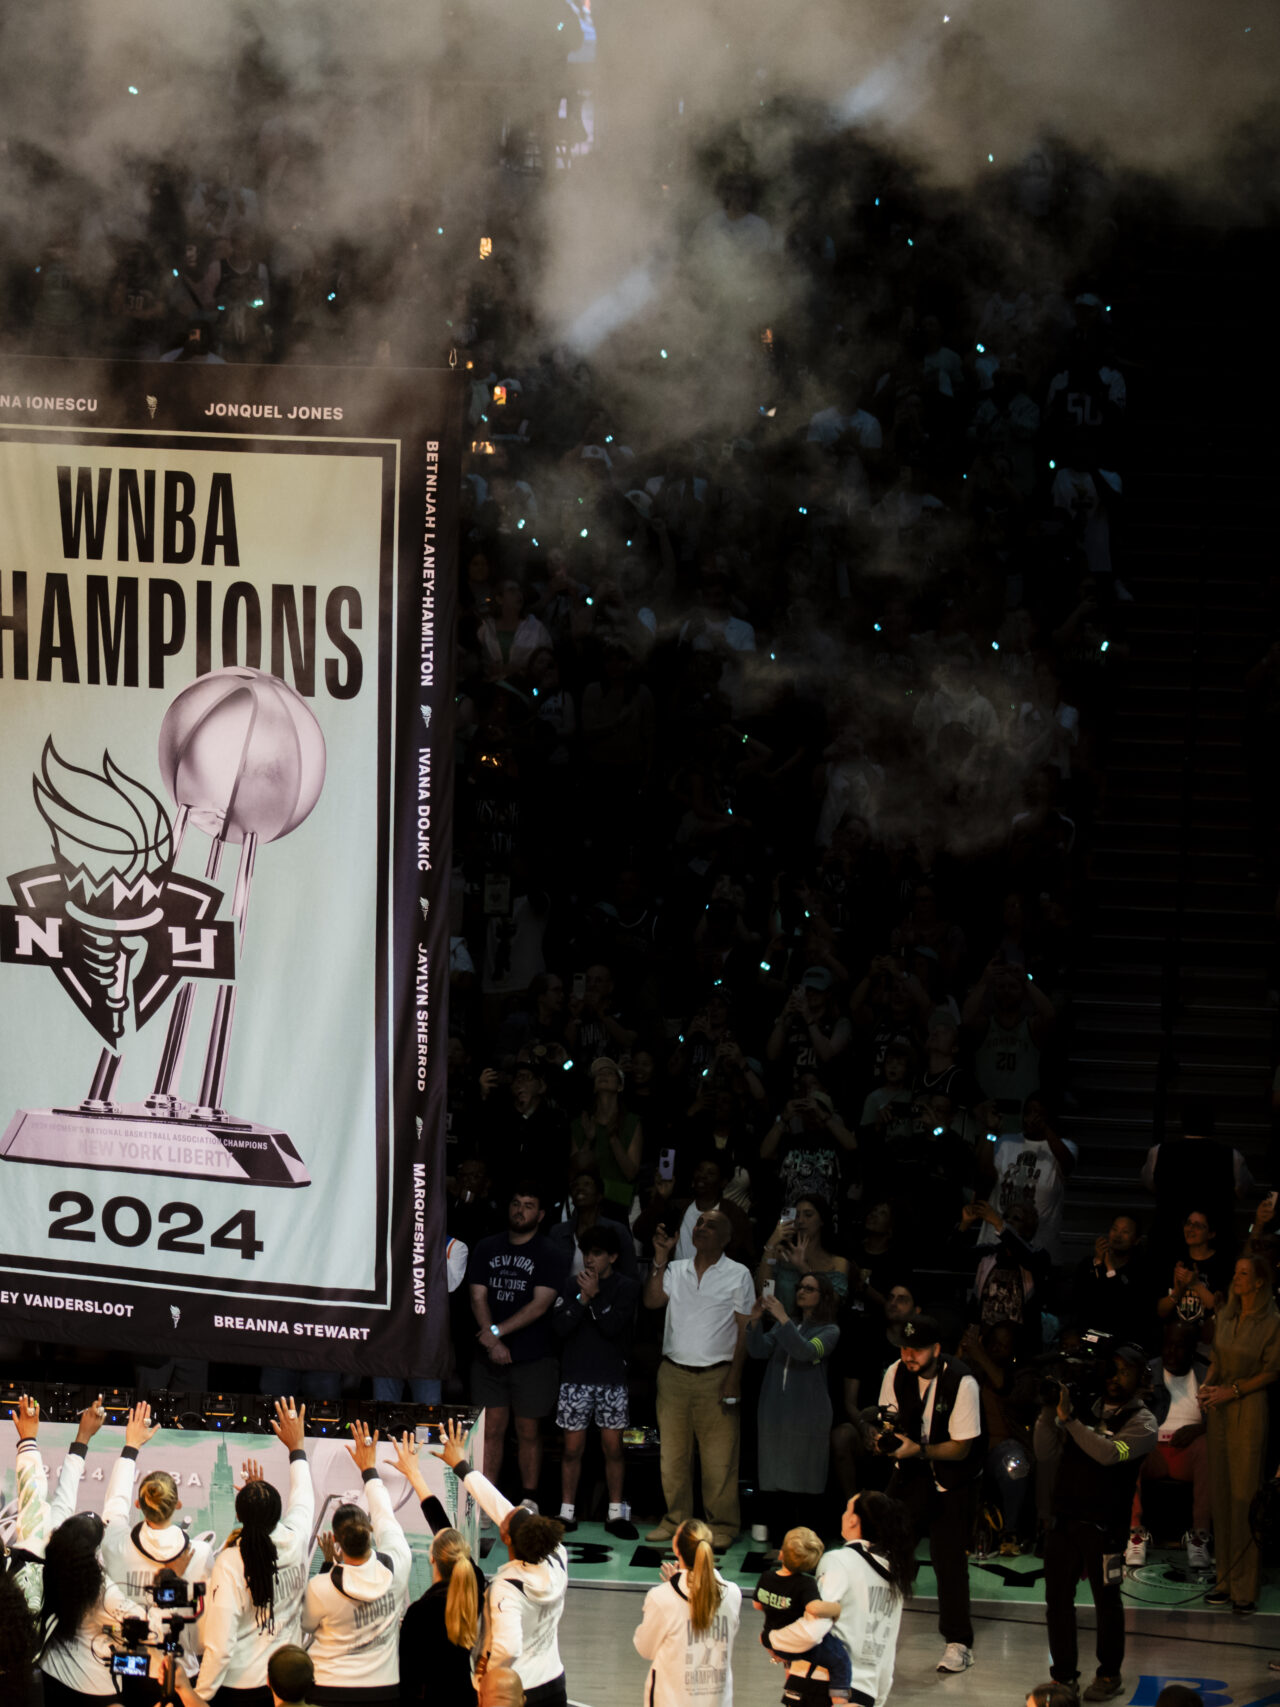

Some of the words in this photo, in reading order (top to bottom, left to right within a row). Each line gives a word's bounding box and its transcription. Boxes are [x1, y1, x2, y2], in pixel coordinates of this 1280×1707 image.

[25, 395, 98, 414] IONESCU
[204, 403, 283, 420] JONQUEL
[287, 406, 344, 421] JONES
[424, 440, 440, 530] BETNIJAH
[56, 466, 240, 567] WNBA
[420, 533, 436, 687] LANEY-HAMILTON
[418, 747, 431, 799] IVANA
[417, 804, 432, 871] DOJKIĆ
[415, 942, 429, 1006] JAYLYN
[416, 1009, 429, 1092] SHERROD
[81, 1139, 114, 1158] NEW
[119, 1141, 163, 1162] YORK
[167, 1146, 233, 1168] LIBERTY
[85, 1127, 122, 1138] NATIONAL
[172, 1133, 222, 1146] ASSOCIATION
[223, 1138, 268, 1151] CHAMPIONS
[47, 1190, 265, 1261] 2024
[412, 1163, 426, 1265] MARQUESHA
[513, 1255, 535, 1275] YORK
[23, 1293, 134, 1318] VANDERSLOOT
[412, 1267, 426, 1315] DAVIS
[214, 1315, 290, 1335] BREANNA
[293, 1322, 371, 1342] STEWART
[353, 1591, 396, 1629] WNBA
